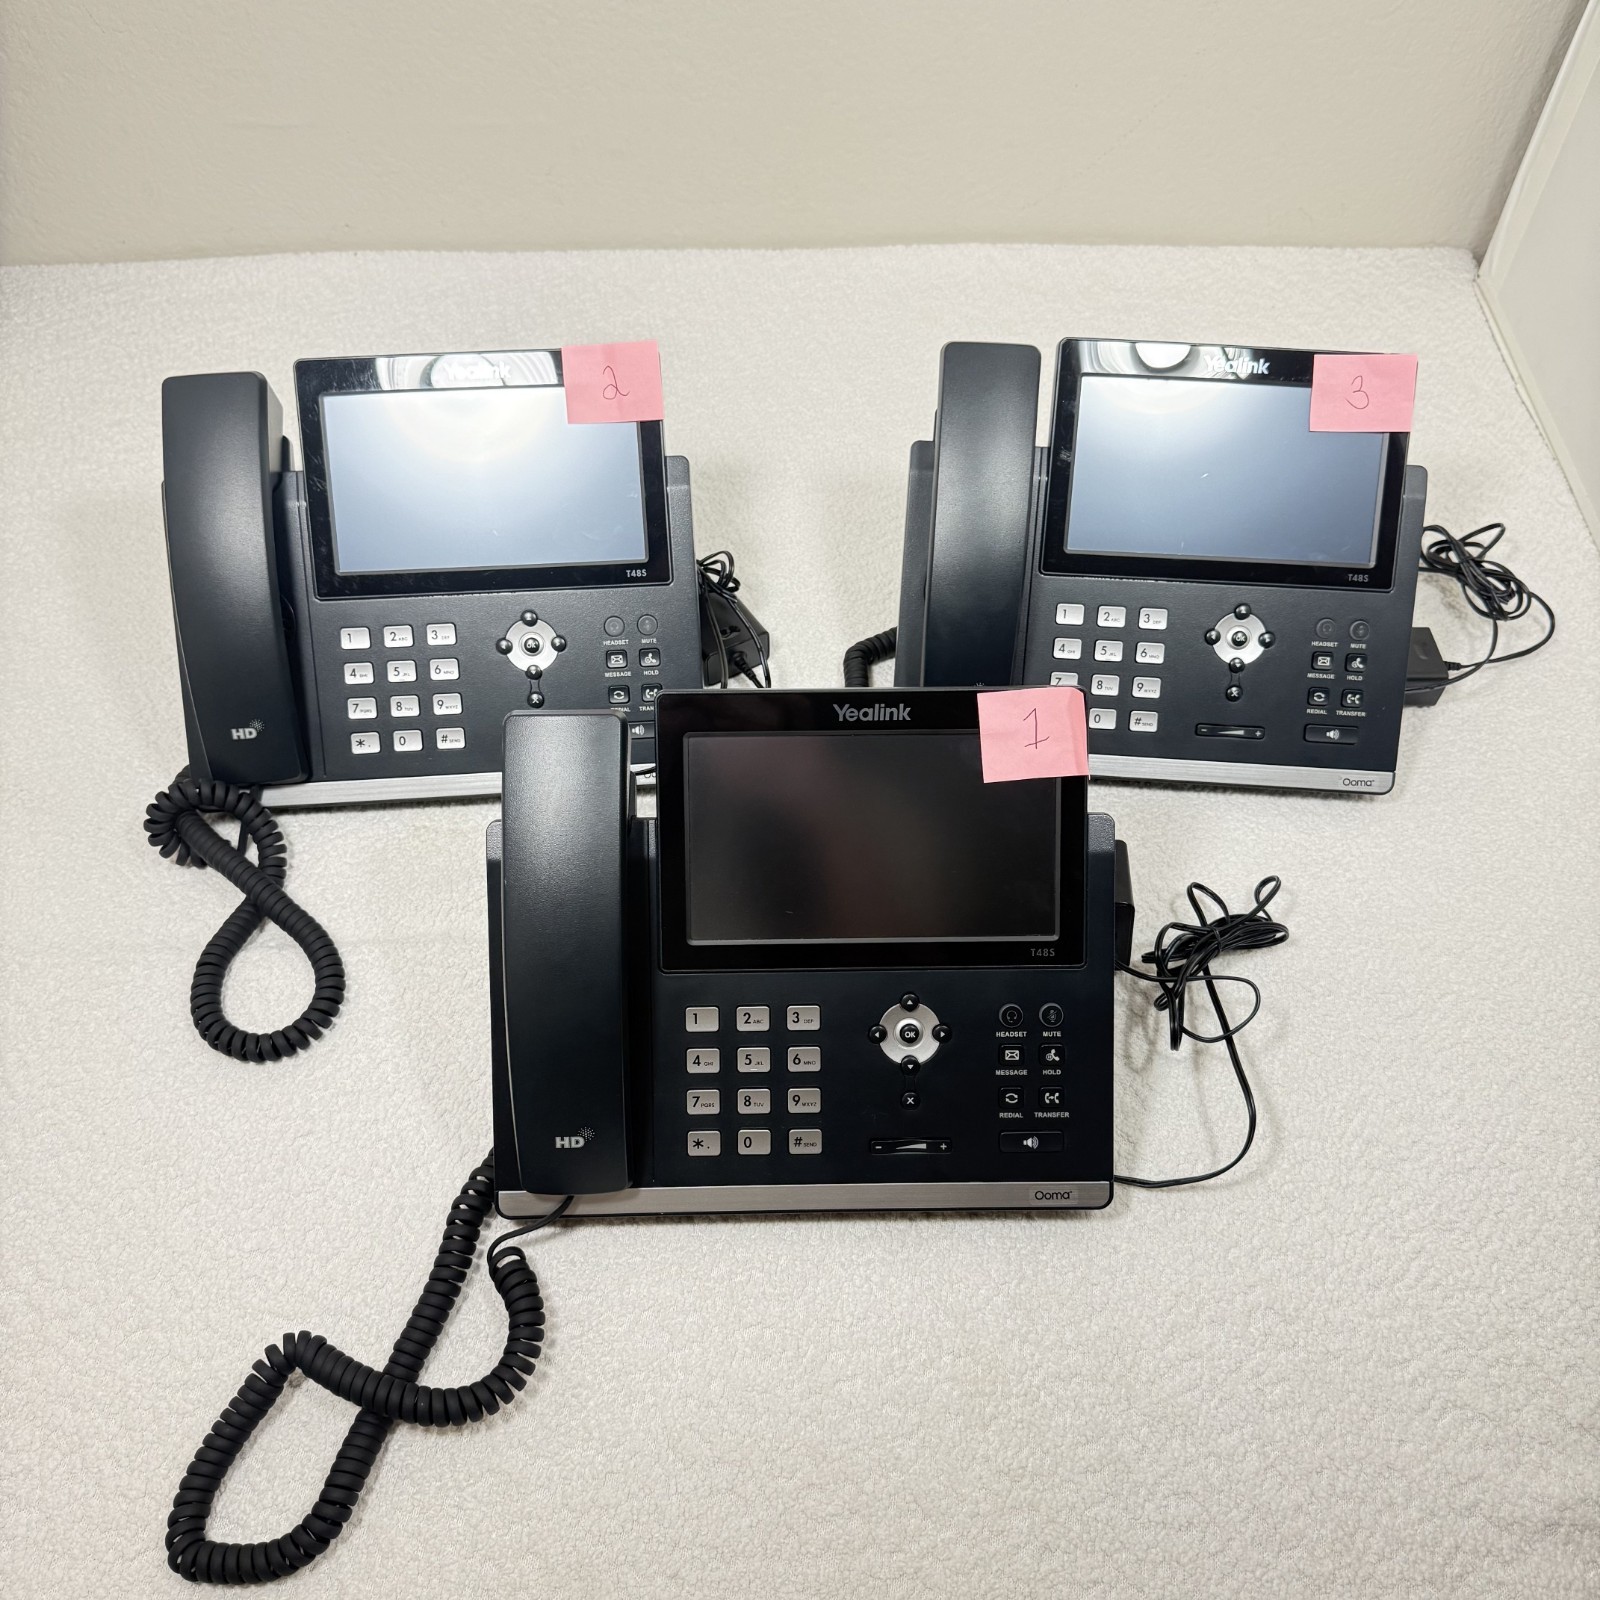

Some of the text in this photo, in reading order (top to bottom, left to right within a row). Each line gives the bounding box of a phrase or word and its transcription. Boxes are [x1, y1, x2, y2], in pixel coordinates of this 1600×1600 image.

[1204, 355, 1270, 374] Yealink
[602, 366, 630, 400] 2
[1345, 376, 1370, 410] 3
[626, 569, 647, 578] T48S
[1348, 574, 1368, 582] T48S
[1062, 609, 1067, 619] 1
[1103, 612, 1110, 621] 2
[1143, 614, 1150, 623] 3
[347, 633, 352, 643] 1
[390, 632, 397, 642] 2
[432, 630, 438, 640] 3
[1059, 643, 1065, 653] 4
[1100, 646, 1107, 656] 5
[1140, 648, 1147, 658] 6
[350, 668, 357, 678] 4
[394, 666, 400, 676] 5
[434, 665, 441, 674] 6
[1055, 677, 1061, 686] 7
[1096, 680, 1103, 690] 8
[1137, 682, 1144, 692] 9
[352, 704, 359, 713] 7
[396, 702, 402, 712] 8
[437, 700, 444, 710] 9
[832, 703, 911, 722] Yealink
[231, 728, 257, 740] HD
[1023, 708, 1050, 750] 1
[1342, 778, 1375, 787] Ooma
[1030, 948, 1056, 958] T48S
[692, 1013, 698, 1024] 1
[743, 1012, 751, 1024] 2
[792, 1012, 799, 1024] 3
[692, 1055, 701, 1066] 4
[744, 1054, 752, 1066] 5
[793, 1053, 801, 1065] 6
[692, 1096, 700, 1108] 7
[744, 1095, 751, 1107] 8
[792, 1094, 800, 1107] 9
[555, 1136, 585, 1148] HD
[744, 1136, 752, 1148] 0
[1034, 1190, 1072, 1200] Ooma
